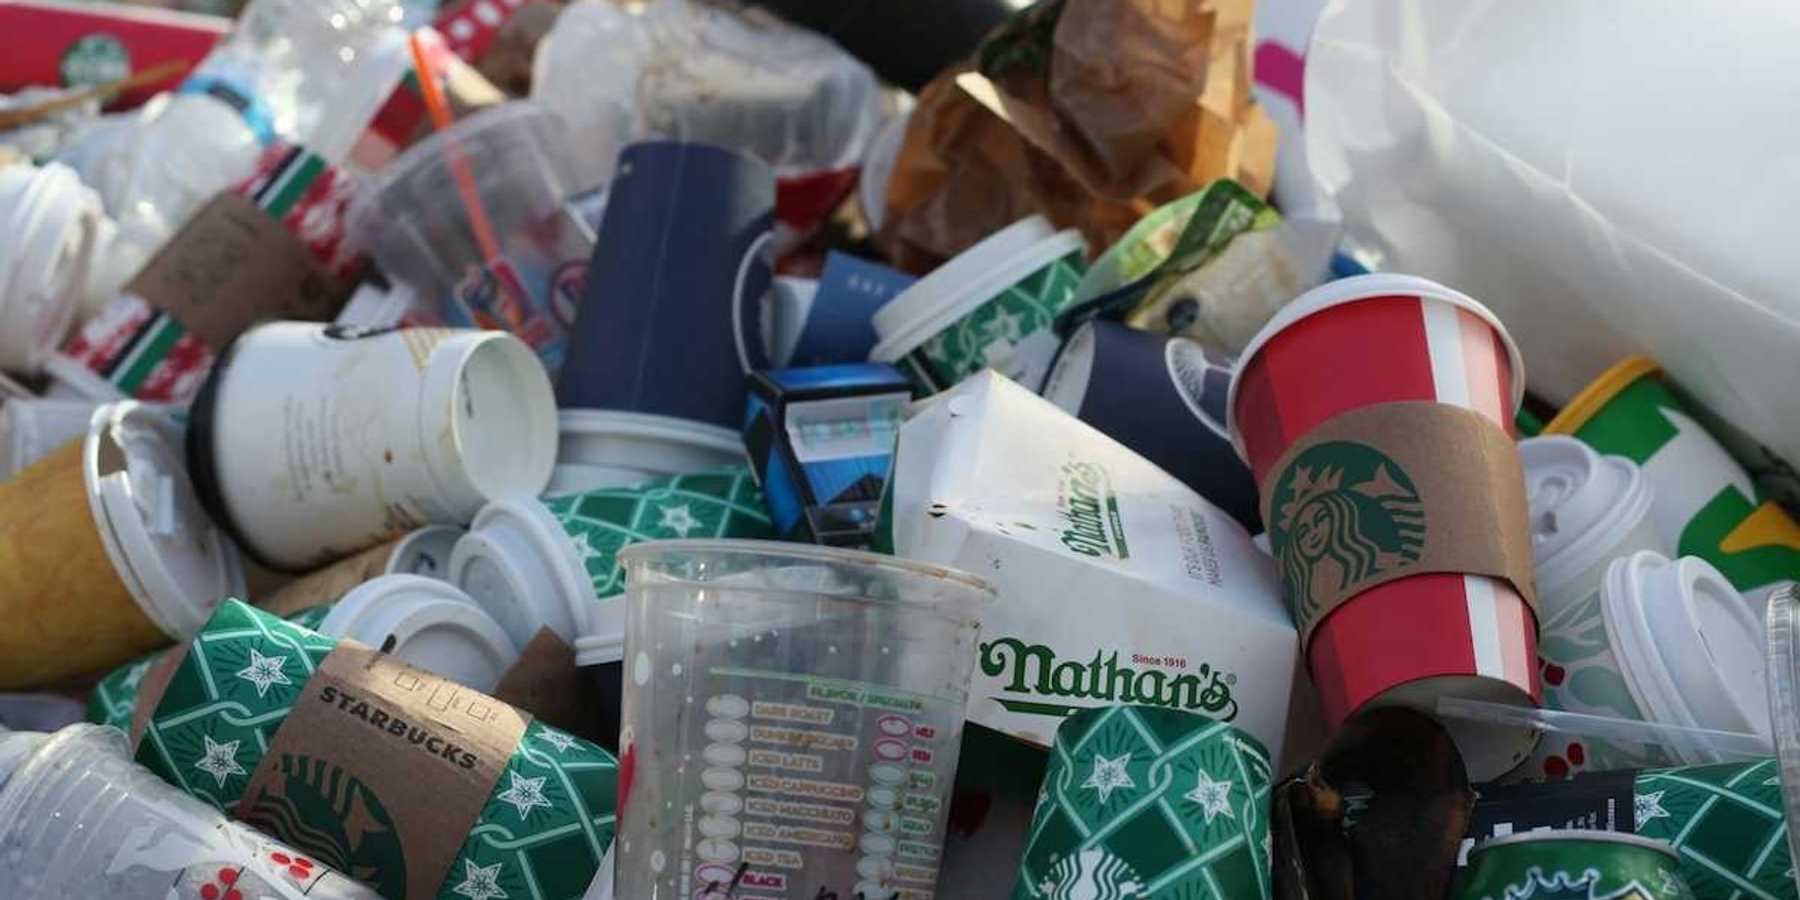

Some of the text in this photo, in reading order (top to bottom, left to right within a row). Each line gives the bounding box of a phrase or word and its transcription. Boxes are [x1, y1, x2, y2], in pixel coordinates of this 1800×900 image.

[1060, 461, 1113, 557] Nathan's
[980, 637, 1239, 722] Nathan's
[1132, 653, 1187, 669] Since 1916
[319, 685, 479, 770] STARBUCKS
